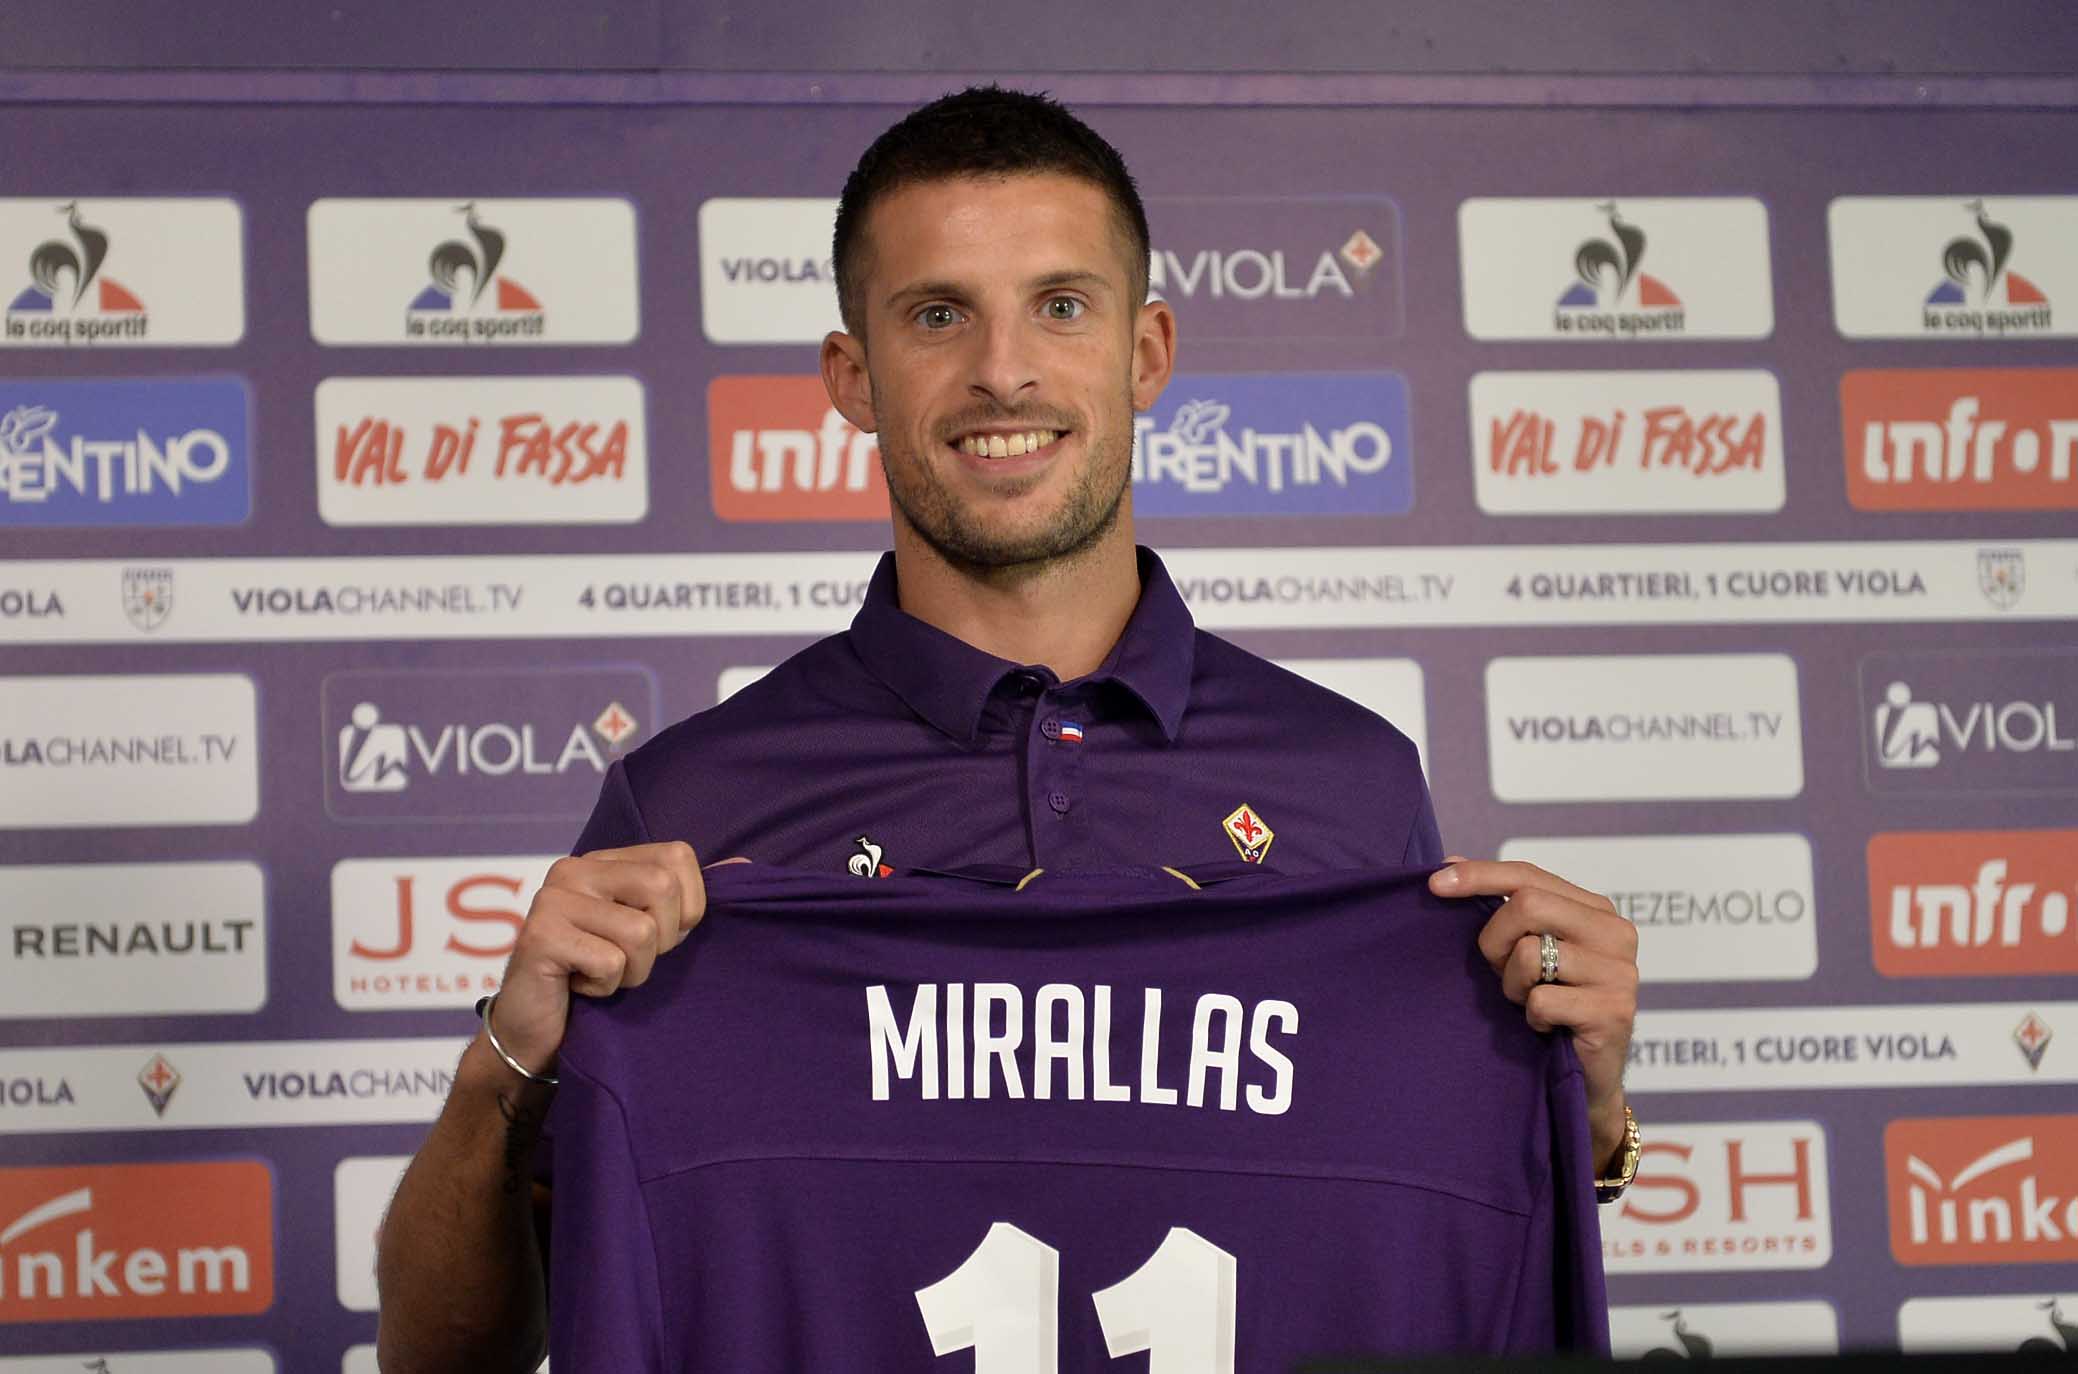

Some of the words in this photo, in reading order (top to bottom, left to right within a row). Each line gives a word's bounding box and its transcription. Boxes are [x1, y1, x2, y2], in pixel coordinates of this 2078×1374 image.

[1165, 249, 1353, 297] VIOLA
[3, 317, 25, 337] le
[30, 317, 71, 343] coq
[75, 315, 147, 343] sportif
[407, 317, 425, 336] le
[430, 317, 470, 342] coq
[474, 315, 544, 342] sportif
[1556, 311, 1572, 331] le
[1577, 314, 1615, 336] coq
[1619, 312, 1685, 336] sportif
[1924, 311, 1941, 328] le
[1946, 312, 1983, 333] coq
[1987, 310, 2051, 333] sportif
[334, 417, 408, 486] VAL
[423, 418, 480, 482] Di
[494, 413, 629, 486] FASSA
[730, 409, 878, 491] infr
[1490, 410, 1560, 476] VAL
[1573, 410, 1626, 472] Di
[1640, 406, 1766, 477] FASSA
[1863, 397, 2078, 483] infro
[0, 428, 229, 501] ENTINO
[232, 586, 521, 614] VIOLACHANNEL.TV
[579, 587, 595, 608] 4
[604, 582, 778, 611] QUARTIERI,
[788, 583, 800, 607] 1
[1506, 576, 1522, 598] 4
[1530, 572, 1699, 600] QUARTIERI,
[1706, 574, 1718, 596] 1
[1726, 571, 1828, 598] CUORE
[1836, 570, 1926, 596] VIOLA
[0, 591, 64, 616] OLA
[1508, 712, 1781, 742] VIOLACHANNEL.TV
[0, 736, 235, 766] LACHANNEL.TV
[350, 875, 525, 961] JS
[1610, 890, 1804, 925] TEZEMOLO
[1890, 859, 2067, 947] infro
[13, 921, 253, 958] RENAULT
[866, 983, 1298, 1115] MIRALLAS
[1629, 1039, 1726, 1067] RTIERI,
[1734, 1040, 1745, 1064] 1
[1754, 1036, 1858, 1064] CUORE
[1865, 1034, 1956, 1060] VIOLA
[0, 1078, 75, 1106] IOLA
[243, 1070, 453, 1098] VIOLACHANN
[1621, 1138, 1812, 1224] SH
[1909, 1176, 2078, 1243] link
[1681, 1236, 1816, 1255] RESORTS
[0, 1229, 250, 1298] nkem
